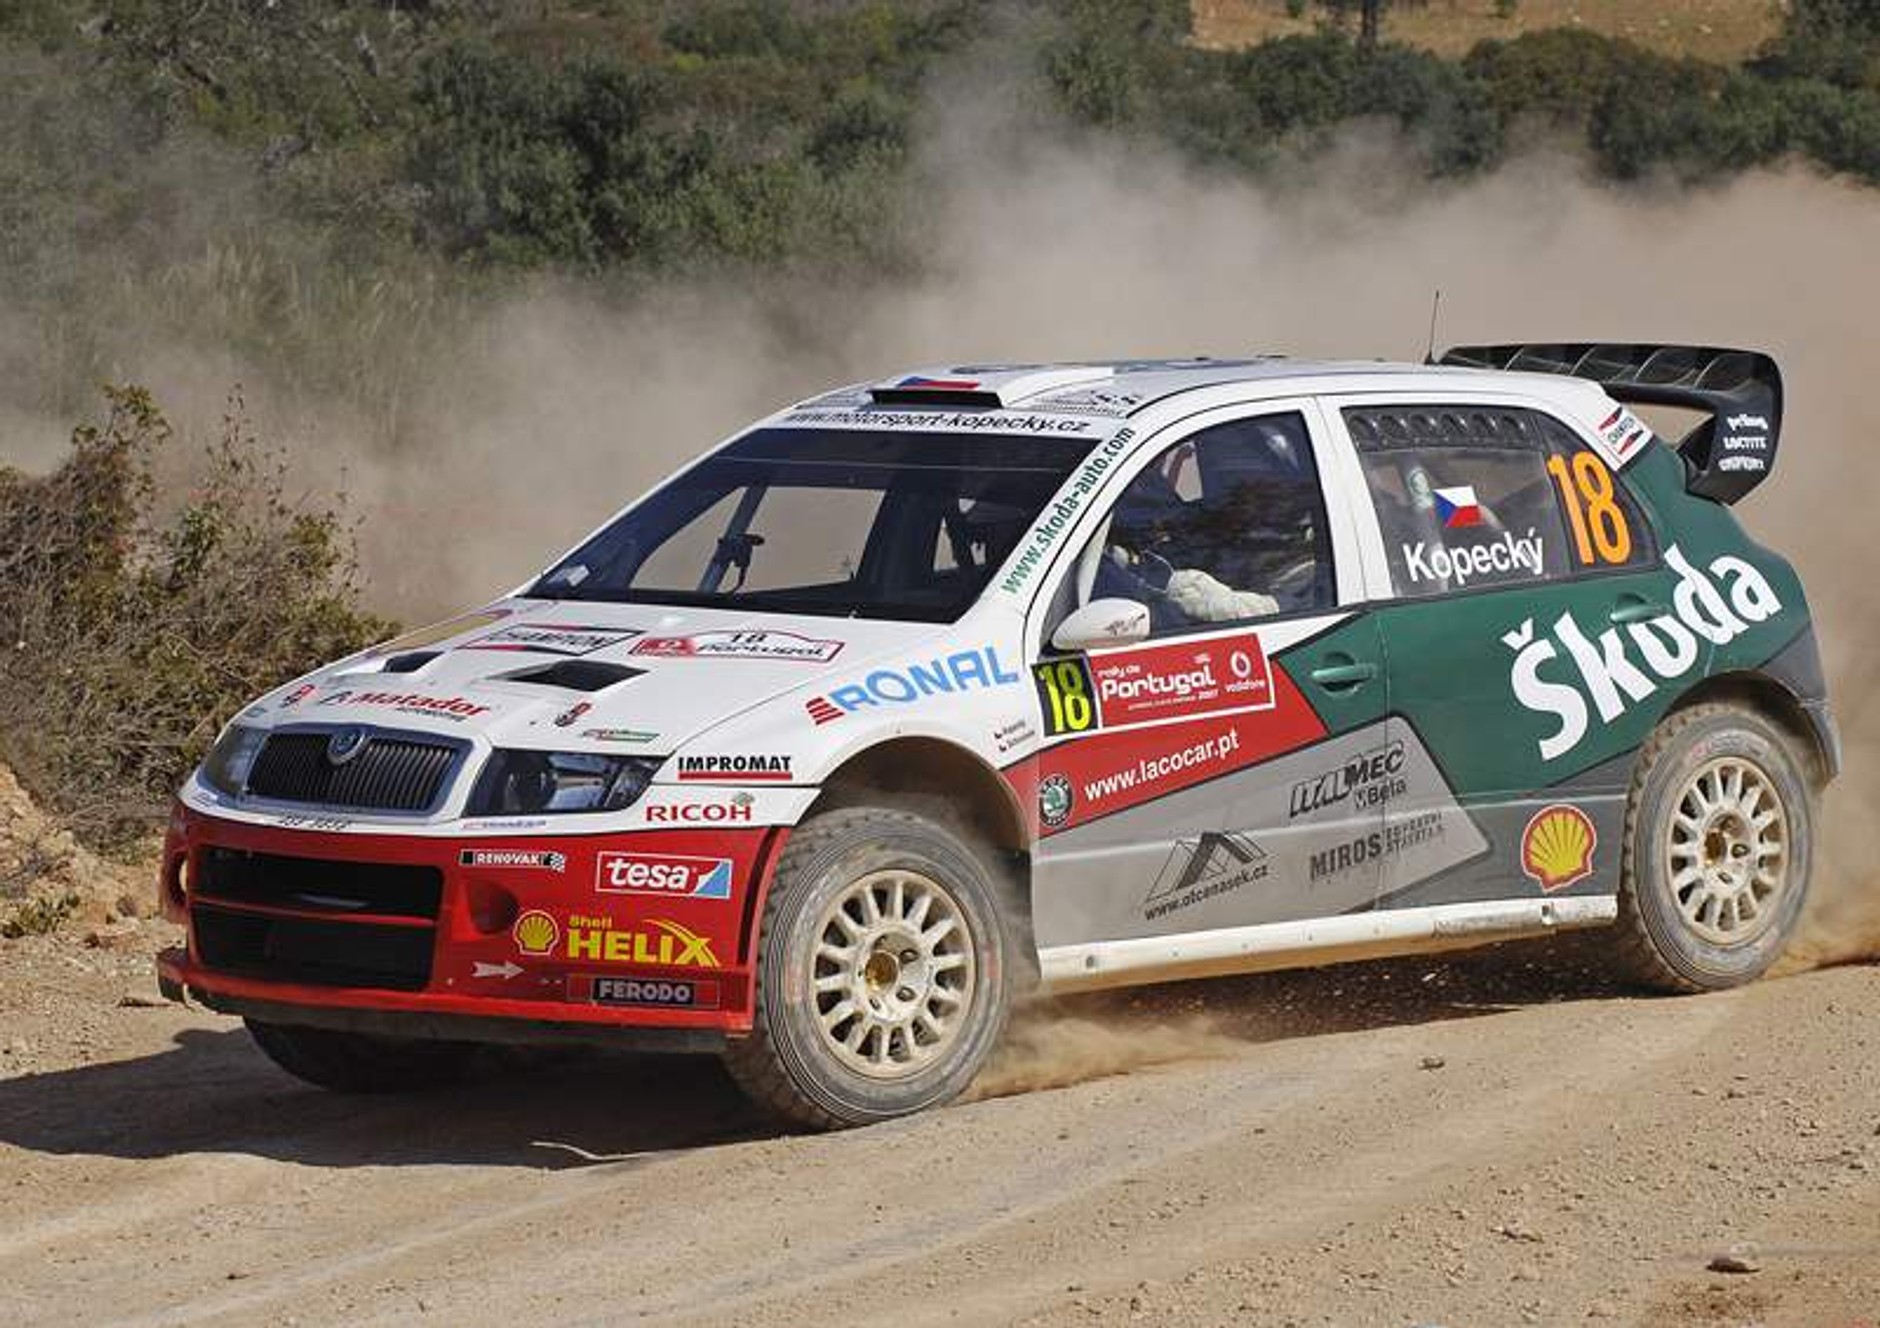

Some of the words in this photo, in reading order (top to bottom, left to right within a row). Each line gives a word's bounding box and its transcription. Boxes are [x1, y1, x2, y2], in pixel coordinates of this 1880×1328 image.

[788, 410, 1091, 432] www.motorsport-kopecky.cz
[1001, 426, 1137, 595] www.skoda-auto.com
[1546, 450, 1632, 565] 18
[1403, 527, 1544, 584] Kopecký
[730, 632, 769, 643] 18
[1502, 543, 1783, 761] Škoda
[829, 646, 1019, 712] RONAL
[1038, 661, 1092, 734] 18
[1102, 664, 1216, 701] Portugal
[678, 756, 792, 773] IMPROMAT
[1084, 728, 1241, 802] www.lacocar.pt
[646, 802, 752, 822] RICOH
[605, 857, 691, 890] tesa
[566, 918, 722, 967] HELIX
[567, 914, 612, 930] Shell
[599, 979, 691, 1001] FERODO
